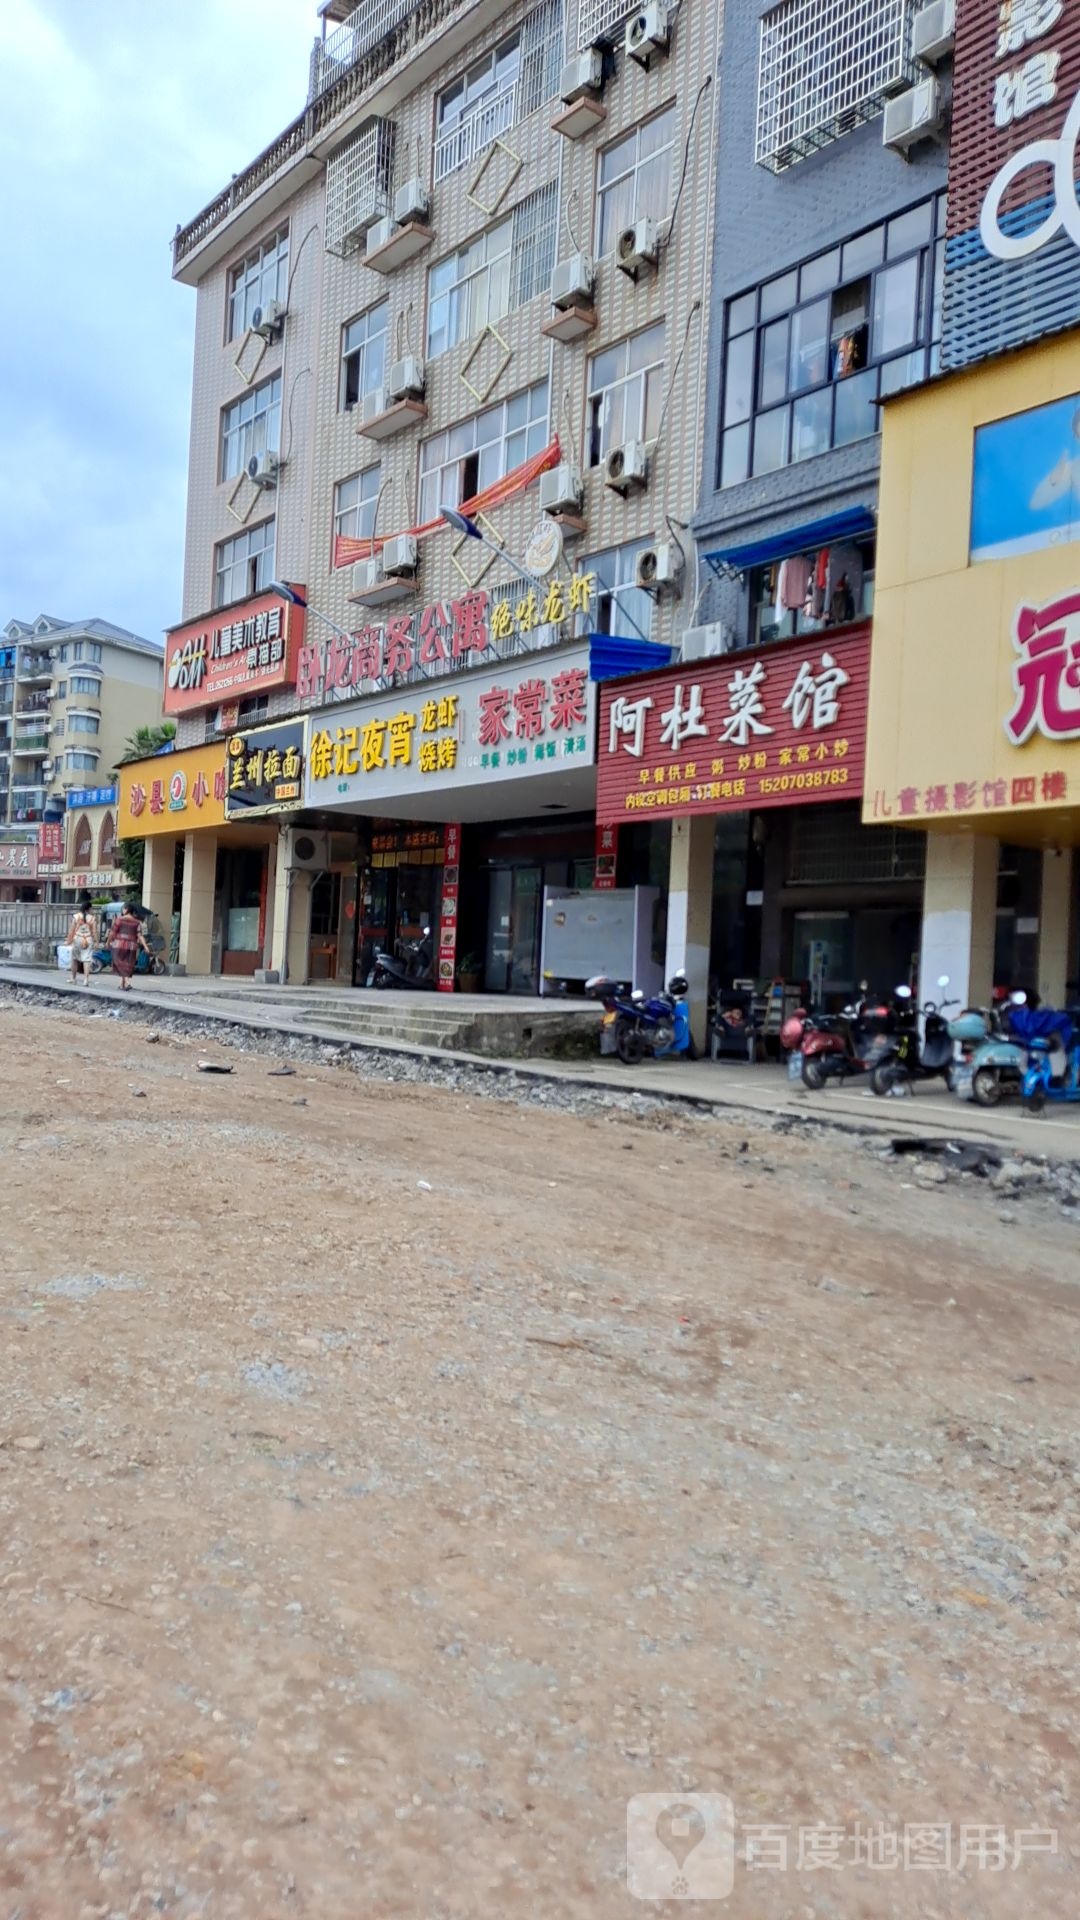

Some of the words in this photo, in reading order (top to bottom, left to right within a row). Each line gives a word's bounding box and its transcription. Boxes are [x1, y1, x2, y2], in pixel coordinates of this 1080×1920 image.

[210, 607, 281, 660] 儿童美术教育
[296, 590, 490, 699] 卧龙商务公寓
[419, 695, 458, 733] 龙虾
[478, 668, 588, 745] 家常菜
[608, 652, 849, 757] 阿杜菜馆
[230, 746, 301, 790] 兰州拉面
[310, 711, 416, 781] 徐记夜宵
[418, 736, 458, 773] 烧烤
[639, 763, 696, 784] 早餐供应
[738, 751, 766, 771] 炒粉
[779, 738, 849, 765] 家常小炒
[130, 778, 164, 817] 沙县
[760, 767, 848, 793] 15207038783
